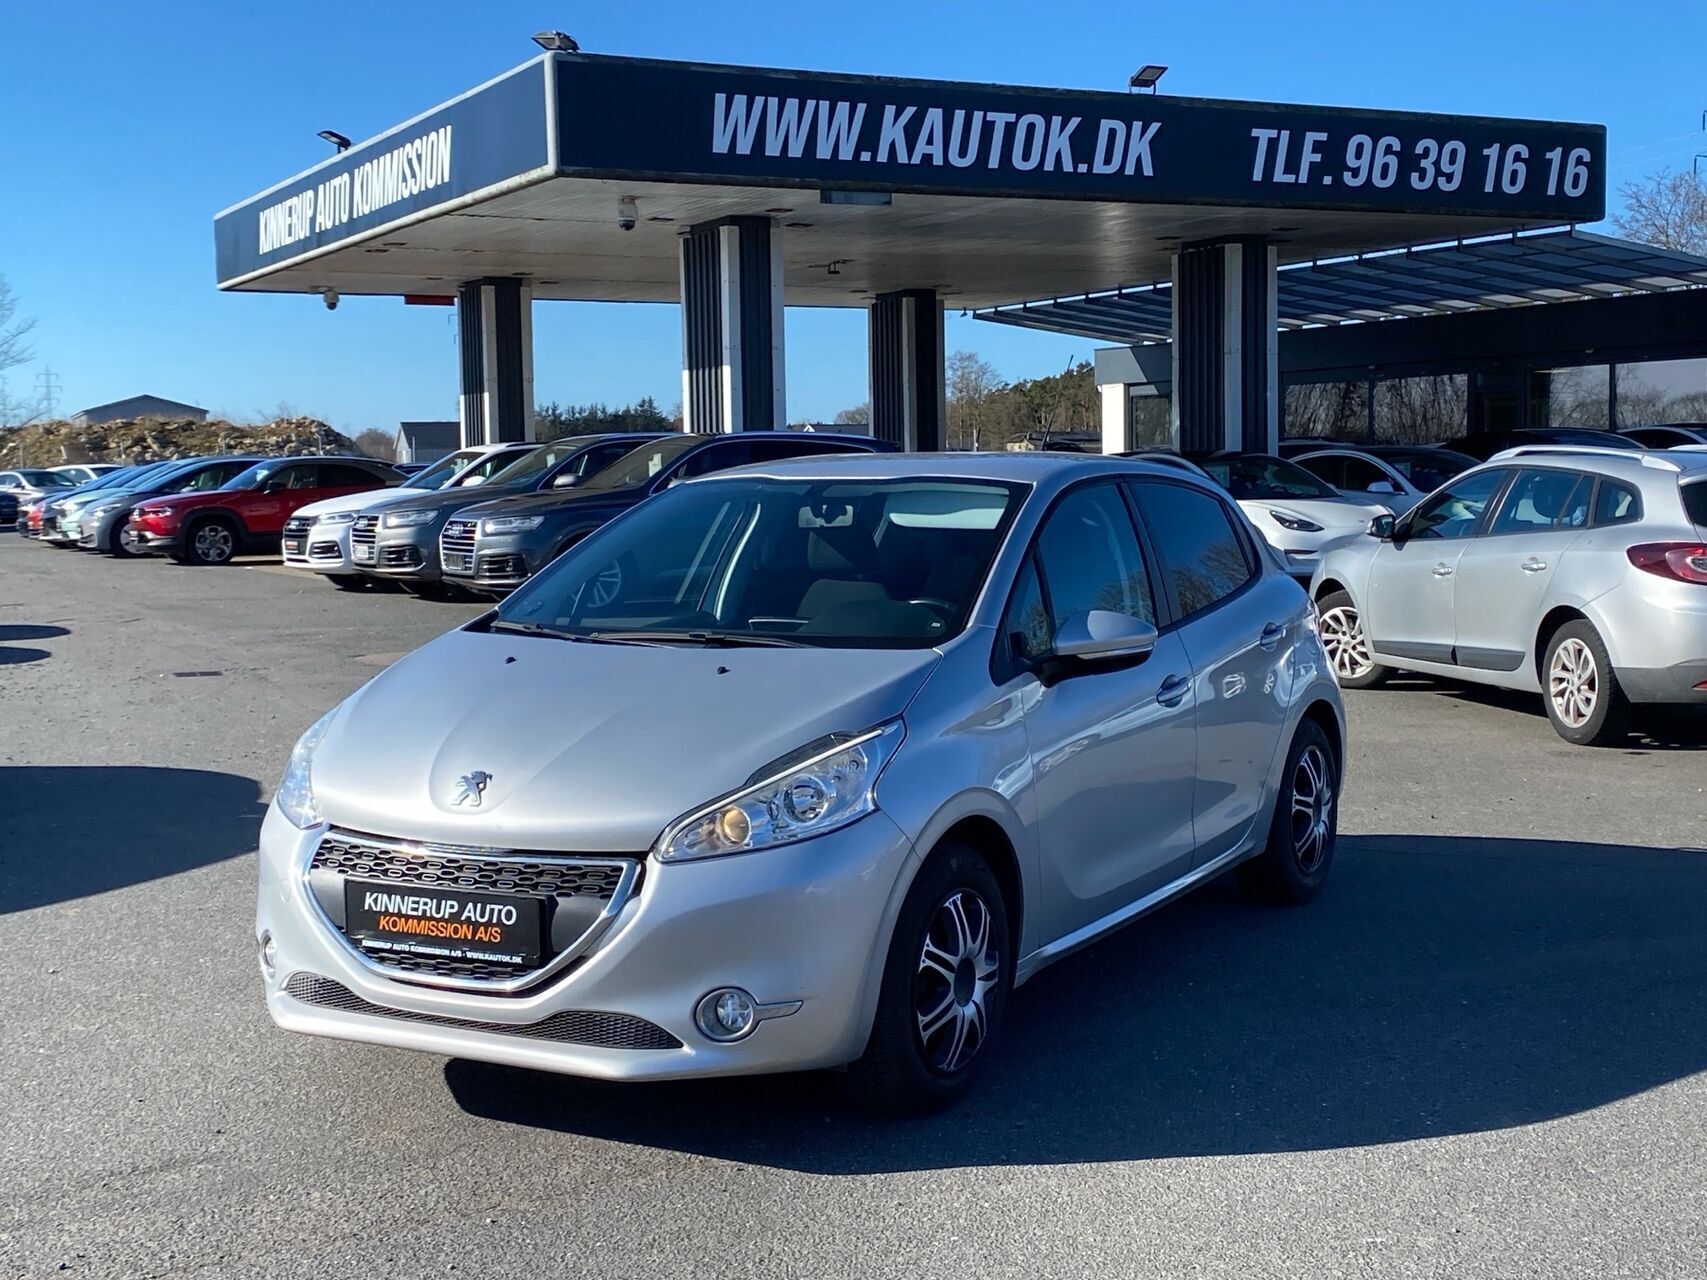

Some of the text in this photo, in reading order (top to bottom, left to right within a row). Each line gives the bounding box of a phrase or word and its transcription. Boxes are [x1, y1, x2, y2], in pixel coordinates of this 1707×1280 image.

[711, 92, 1163, 177] WWW.KAUTOK.DK
[1250, 128, 1592, 198] TLF. 96 39 16 16
[259, 125, 452, 255] KINNERUP AUTO KOMMISSION
[364, 892, 517, 926] KINNERUP AUTO
[379, 916, 502, 943] KOMMISSION A/S
[392, 943, 410, 952] AUTO
